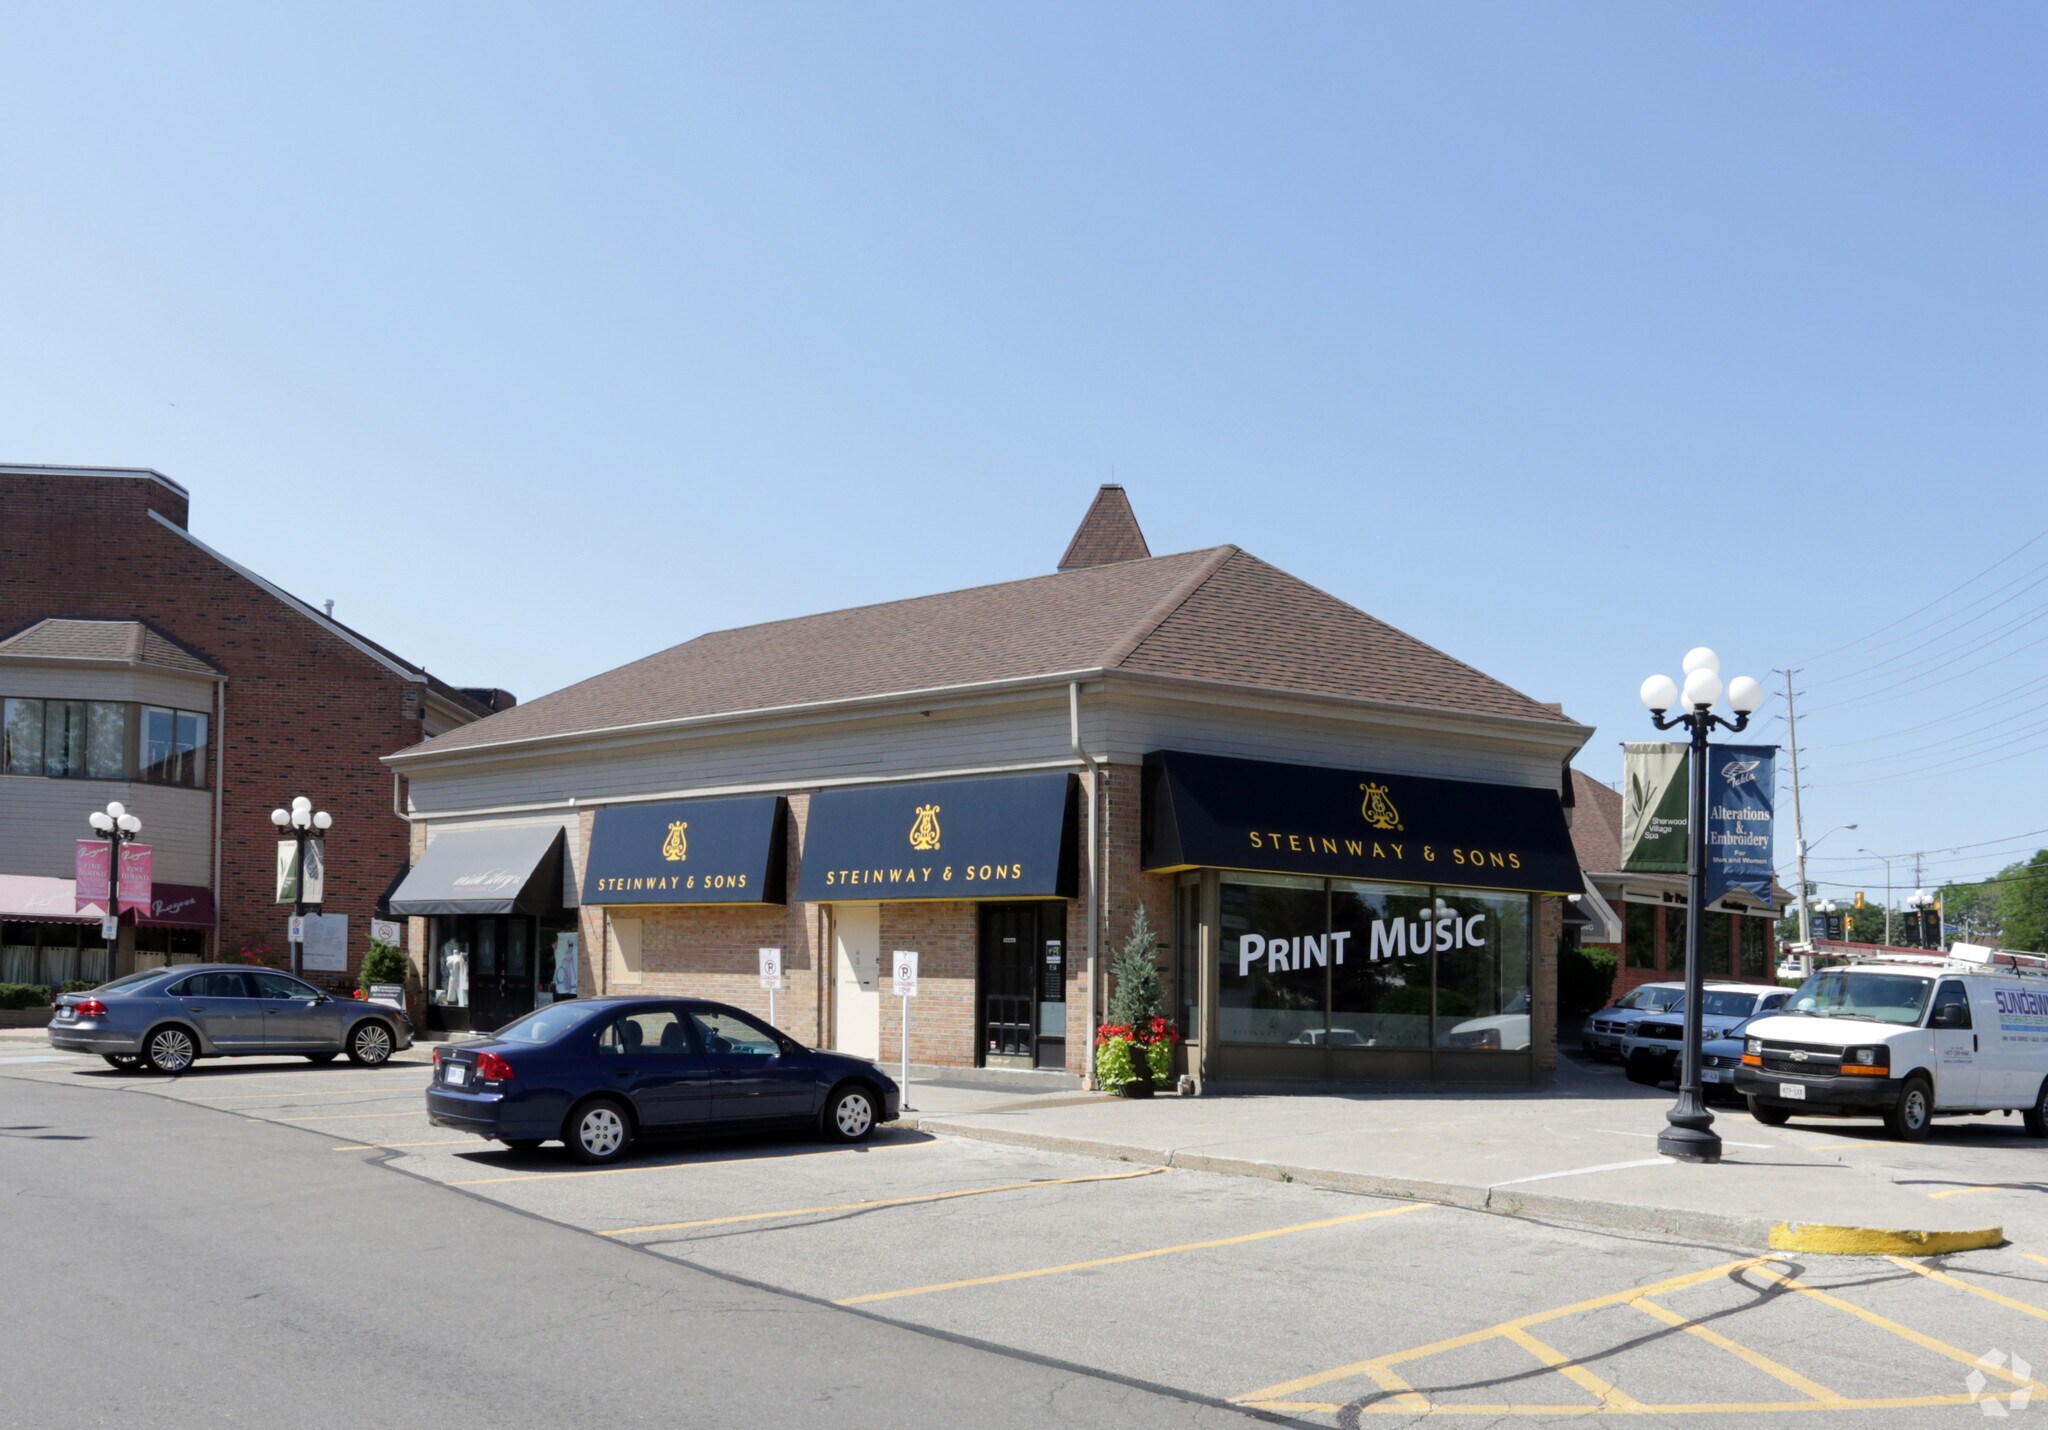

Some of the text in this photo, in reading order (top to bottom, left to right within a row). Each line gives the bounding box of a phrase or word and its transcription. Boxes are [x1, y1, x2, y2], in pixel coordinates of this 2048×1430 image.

[1710, 806, 1770, 821] Alterations
[1649, 825, 1673, 833] Village
[1651, 817, 1687, 826] Sherwood
[1735, 820, 1744, 834] &
[1644, 832, 1659, 840] Spa
[1710, 831, 1769, 849] Embroidery
[1249, 831, 1521, 869] STEINWAY & SONS
[598, 874, 747, 891] STEINWAY & SONS
[826, 864, 1022, 886] STEINWAY & SONS
